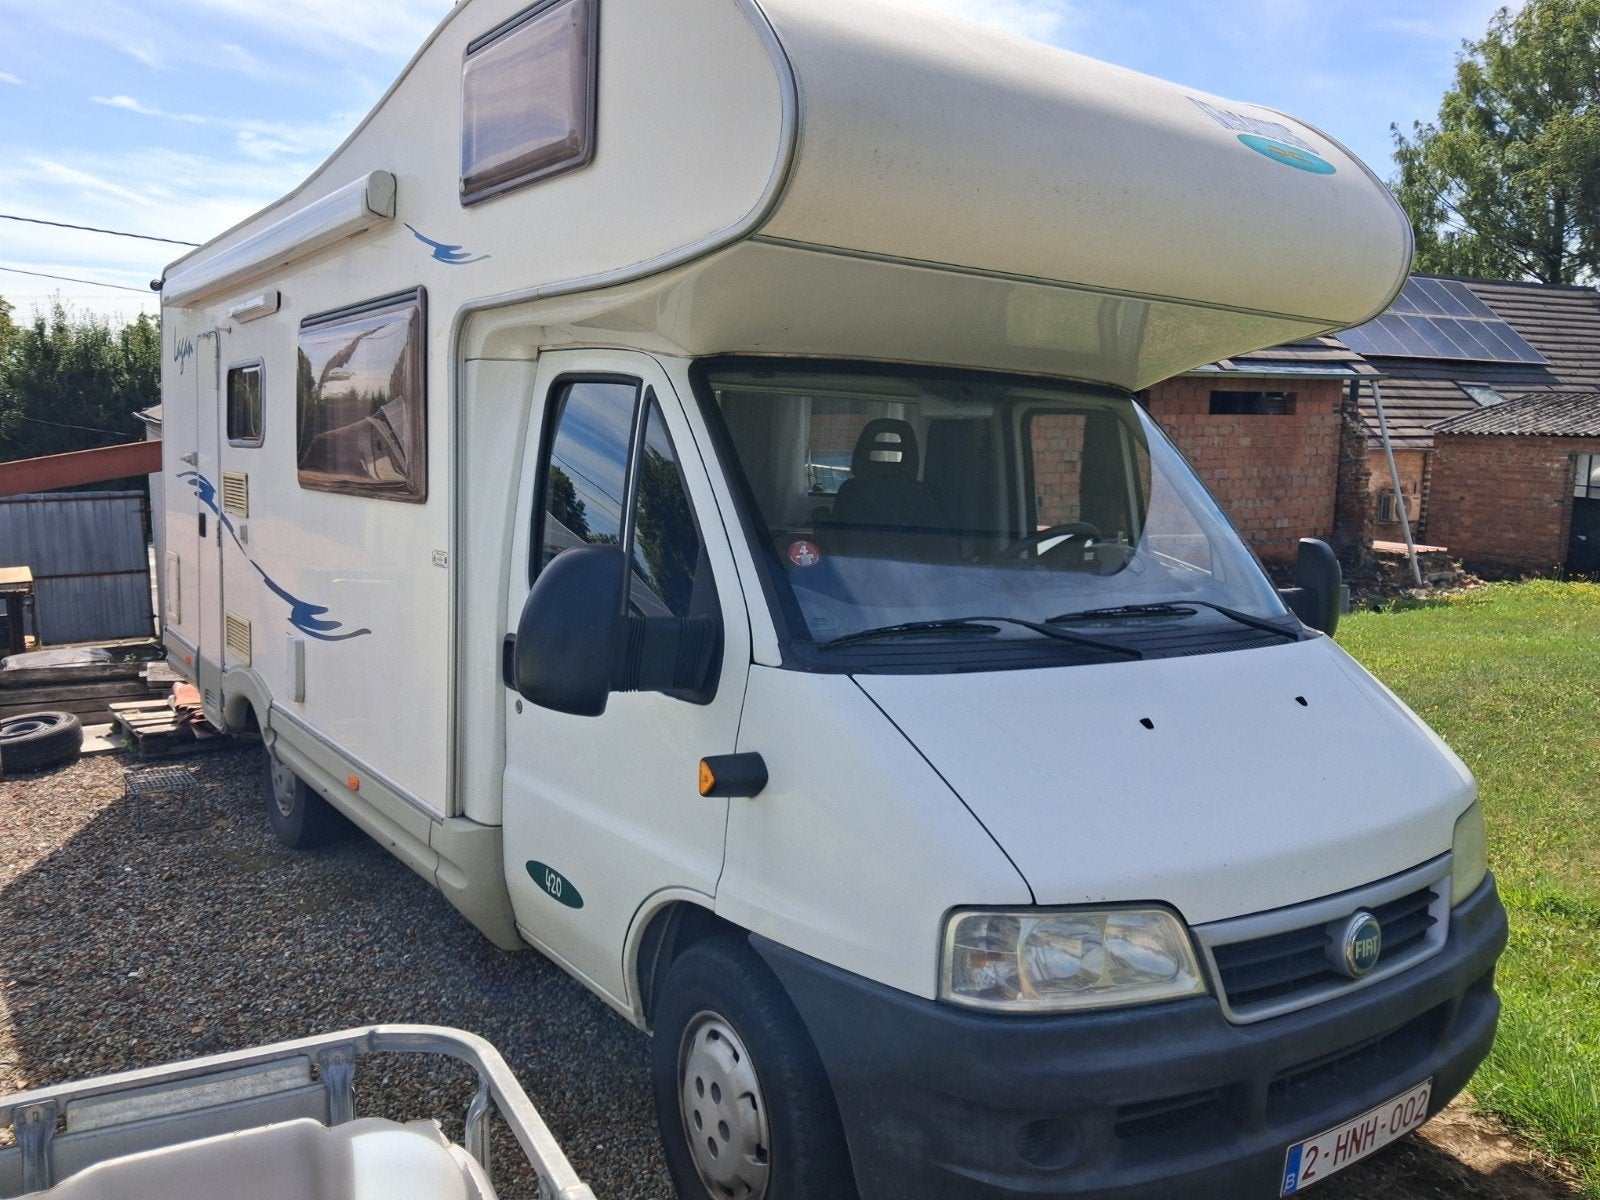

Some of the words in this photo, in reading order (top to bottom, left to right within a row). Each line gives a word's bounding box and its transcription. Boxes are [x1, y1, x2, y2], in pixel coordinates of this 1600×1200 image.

[799, 545, 809, 555] 4
[545, 868, 562, 898] 420
[1355, 935, 1378, 960] FIAT
[1285, 1173, 1296, 1189] B
[1301, 1089, 1428, 1182] 2-HNH-002
